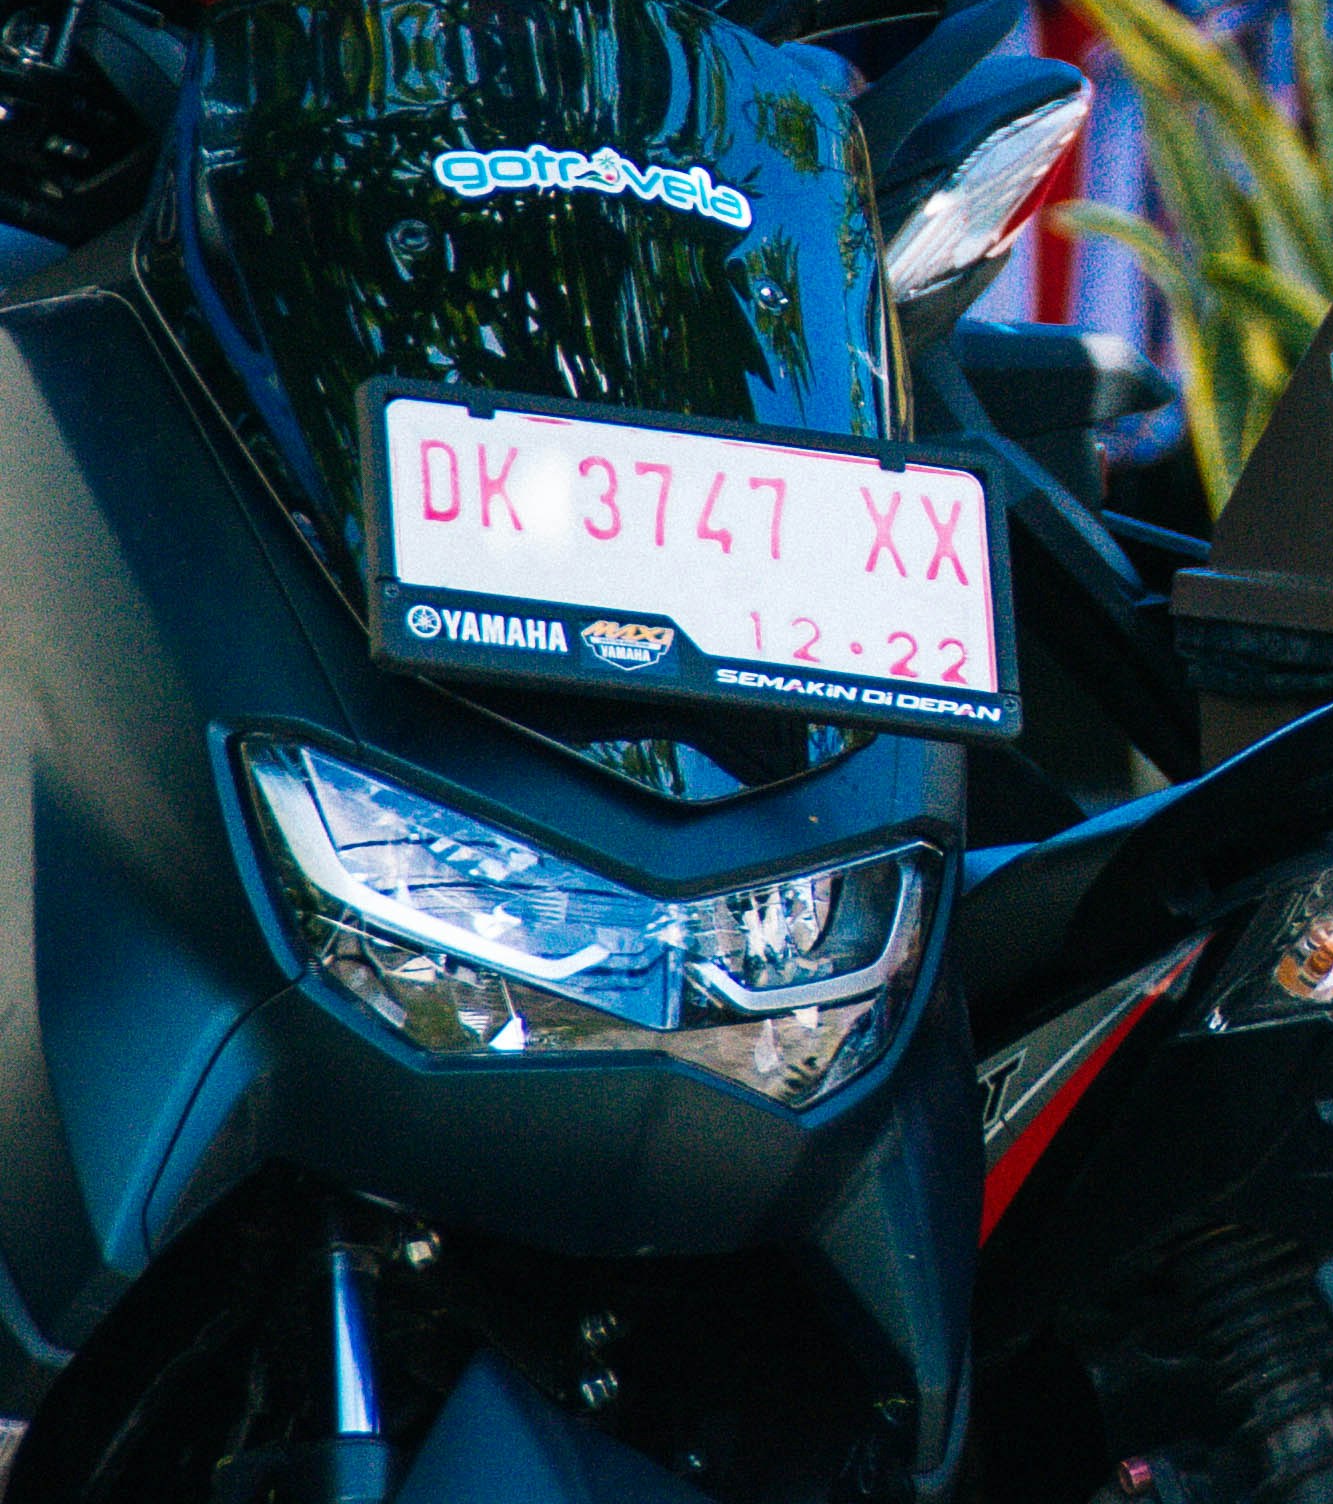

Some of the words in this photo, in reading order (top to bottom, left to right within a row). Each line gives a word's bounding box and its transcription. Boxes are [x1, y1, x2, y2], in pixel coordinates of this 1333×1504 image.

[420, 438, 523, 534] DK
[578, 455, 788, 562] 3747
[859, 485, 971, 589] XX
[441, 608, 568, 653] YAMAHA
[601, 644, 651, 662] YAMAHA
[896, 694, 1001, 722] DEPAN
